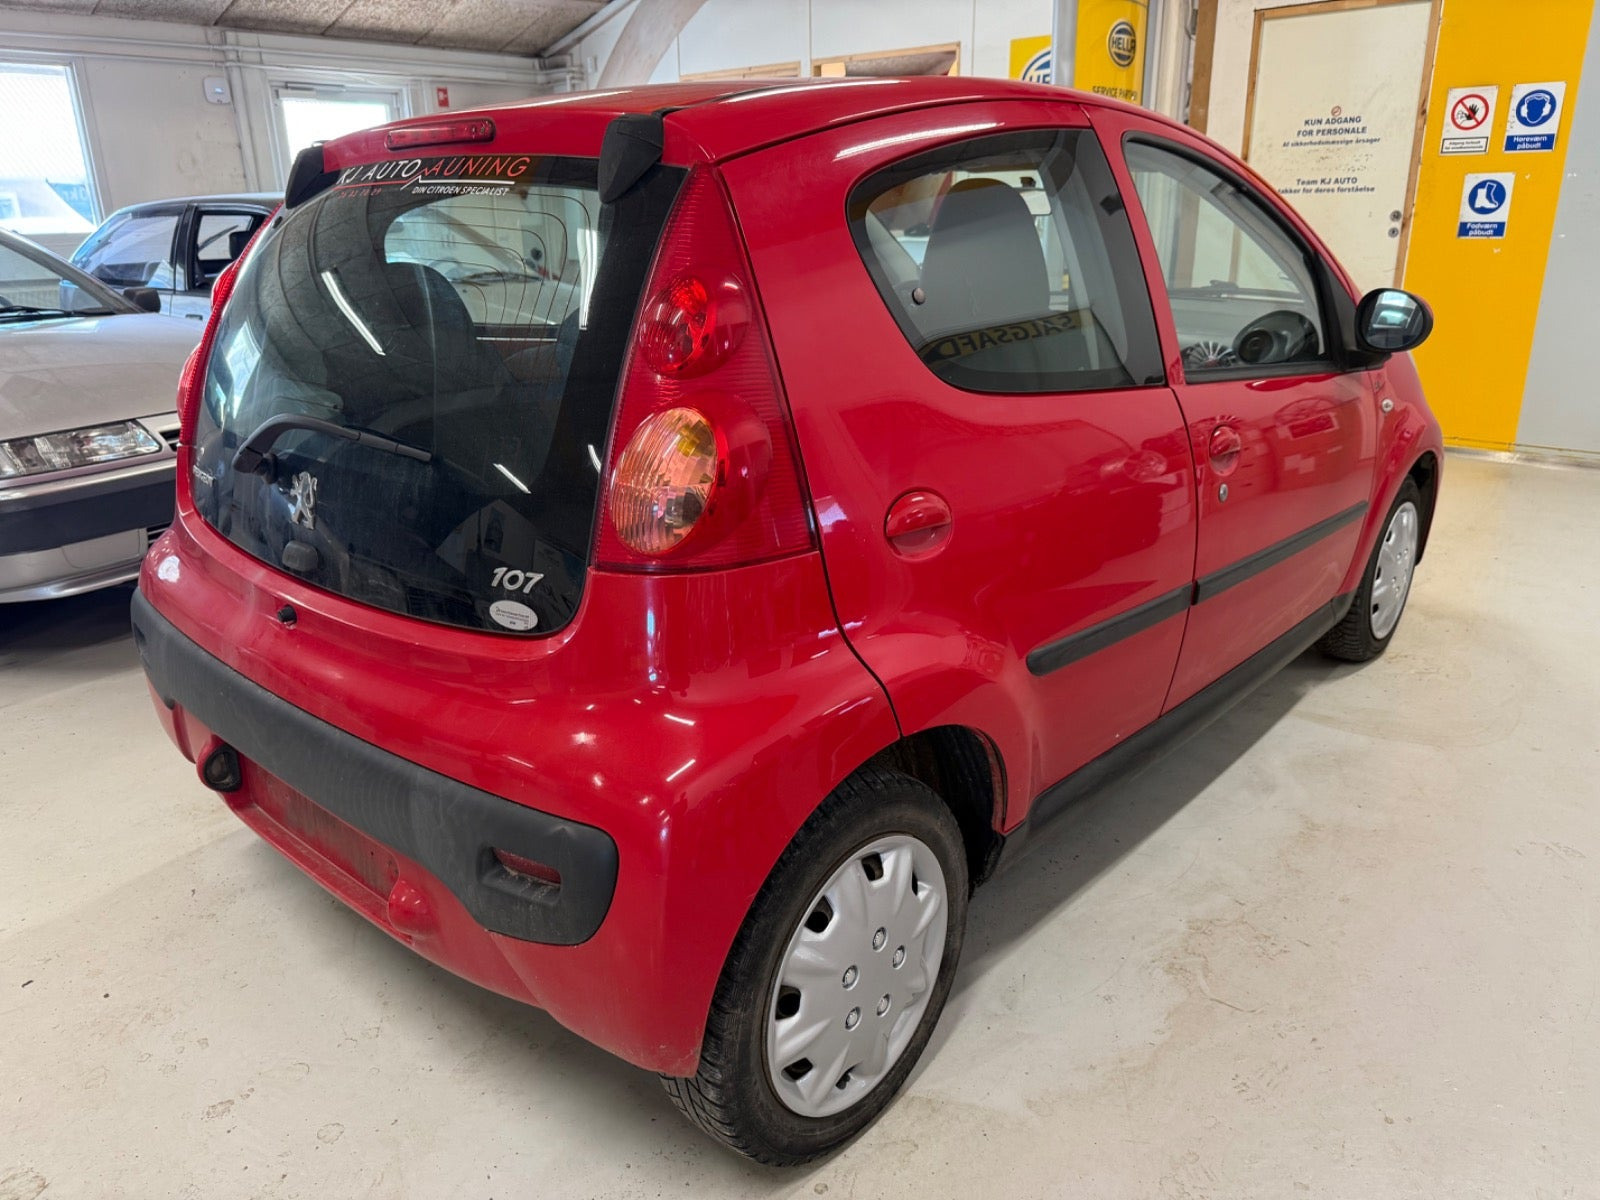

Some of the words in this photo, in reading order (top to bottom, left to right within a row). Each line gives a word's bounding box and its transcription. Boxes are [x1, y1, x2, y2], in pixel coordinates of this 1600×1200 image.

[1111, 36, 1136, 53] HELLA
[1304, 118, 1323, 127] KUN
[1325, 116, 1362, 125] ADGANG
[1297, 129, 1314, 137] FOR
[1316, 126, 1367, 136] PERSONALE
[336, 165, 363, 185] KJ
[361, 159, 421, 181] AUTO
[427, 157, 531, 177] AUNING
[1320, 177, 1332, 185] KJ
[1333, 177, 1358, 185] AUTO
[412, 186, 427, 194] DIN
[461, 186, 510, 196] SPECIALIST
[491, 566, 544, 594] 107
